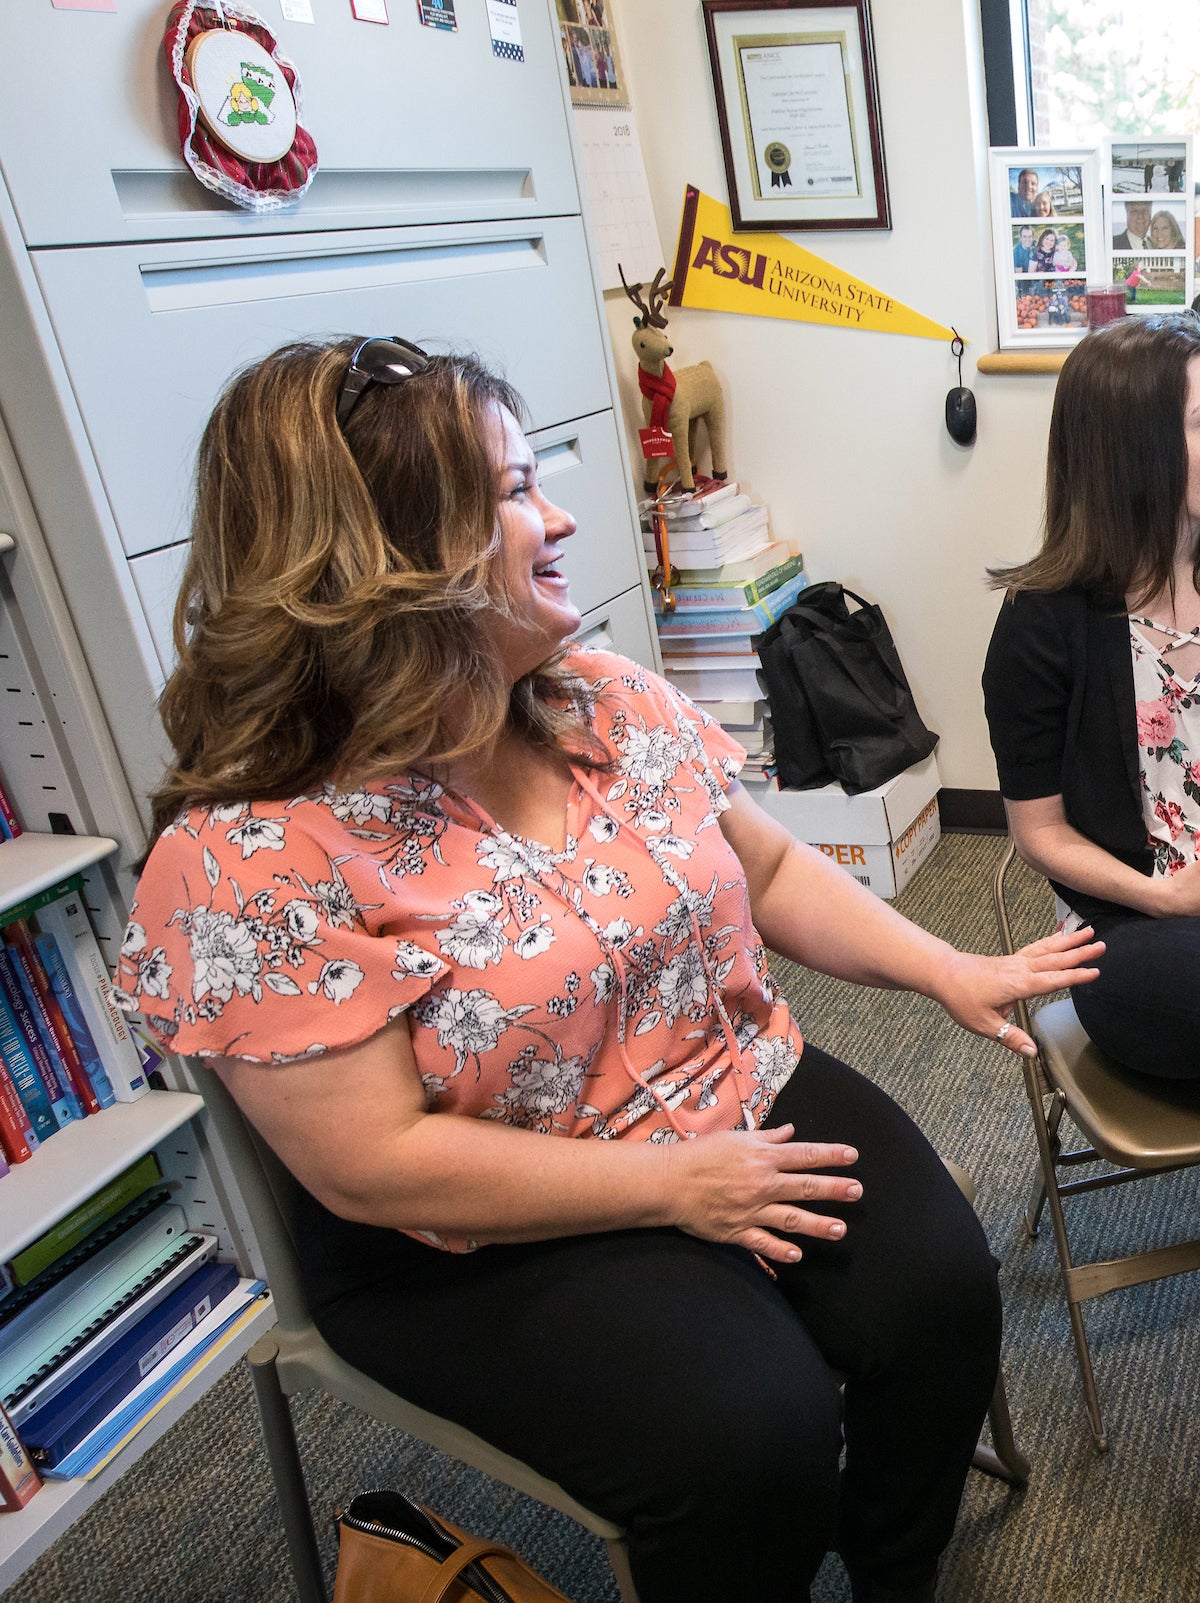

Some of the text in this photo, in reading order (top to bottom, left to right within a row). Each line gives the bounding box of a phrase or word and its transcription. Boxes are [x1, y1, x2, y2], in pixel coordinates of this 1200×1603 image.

[613, 125, 630, 137] 2018
[692, 235, 894, 314] ASU ARIZONA STATE
[769, 277, 865, 323] UNIVERSITY
[899, 823, 917, 854] COPY
[917, 799, 937, 832] PAPER
[820, 844, 867, 866] PER
[0, 951, 38, 1043] Pharmacology Success
[4, 1036, 21, 1056] FOR
[9, 1050, 36, 1092] NCLEX-RN
